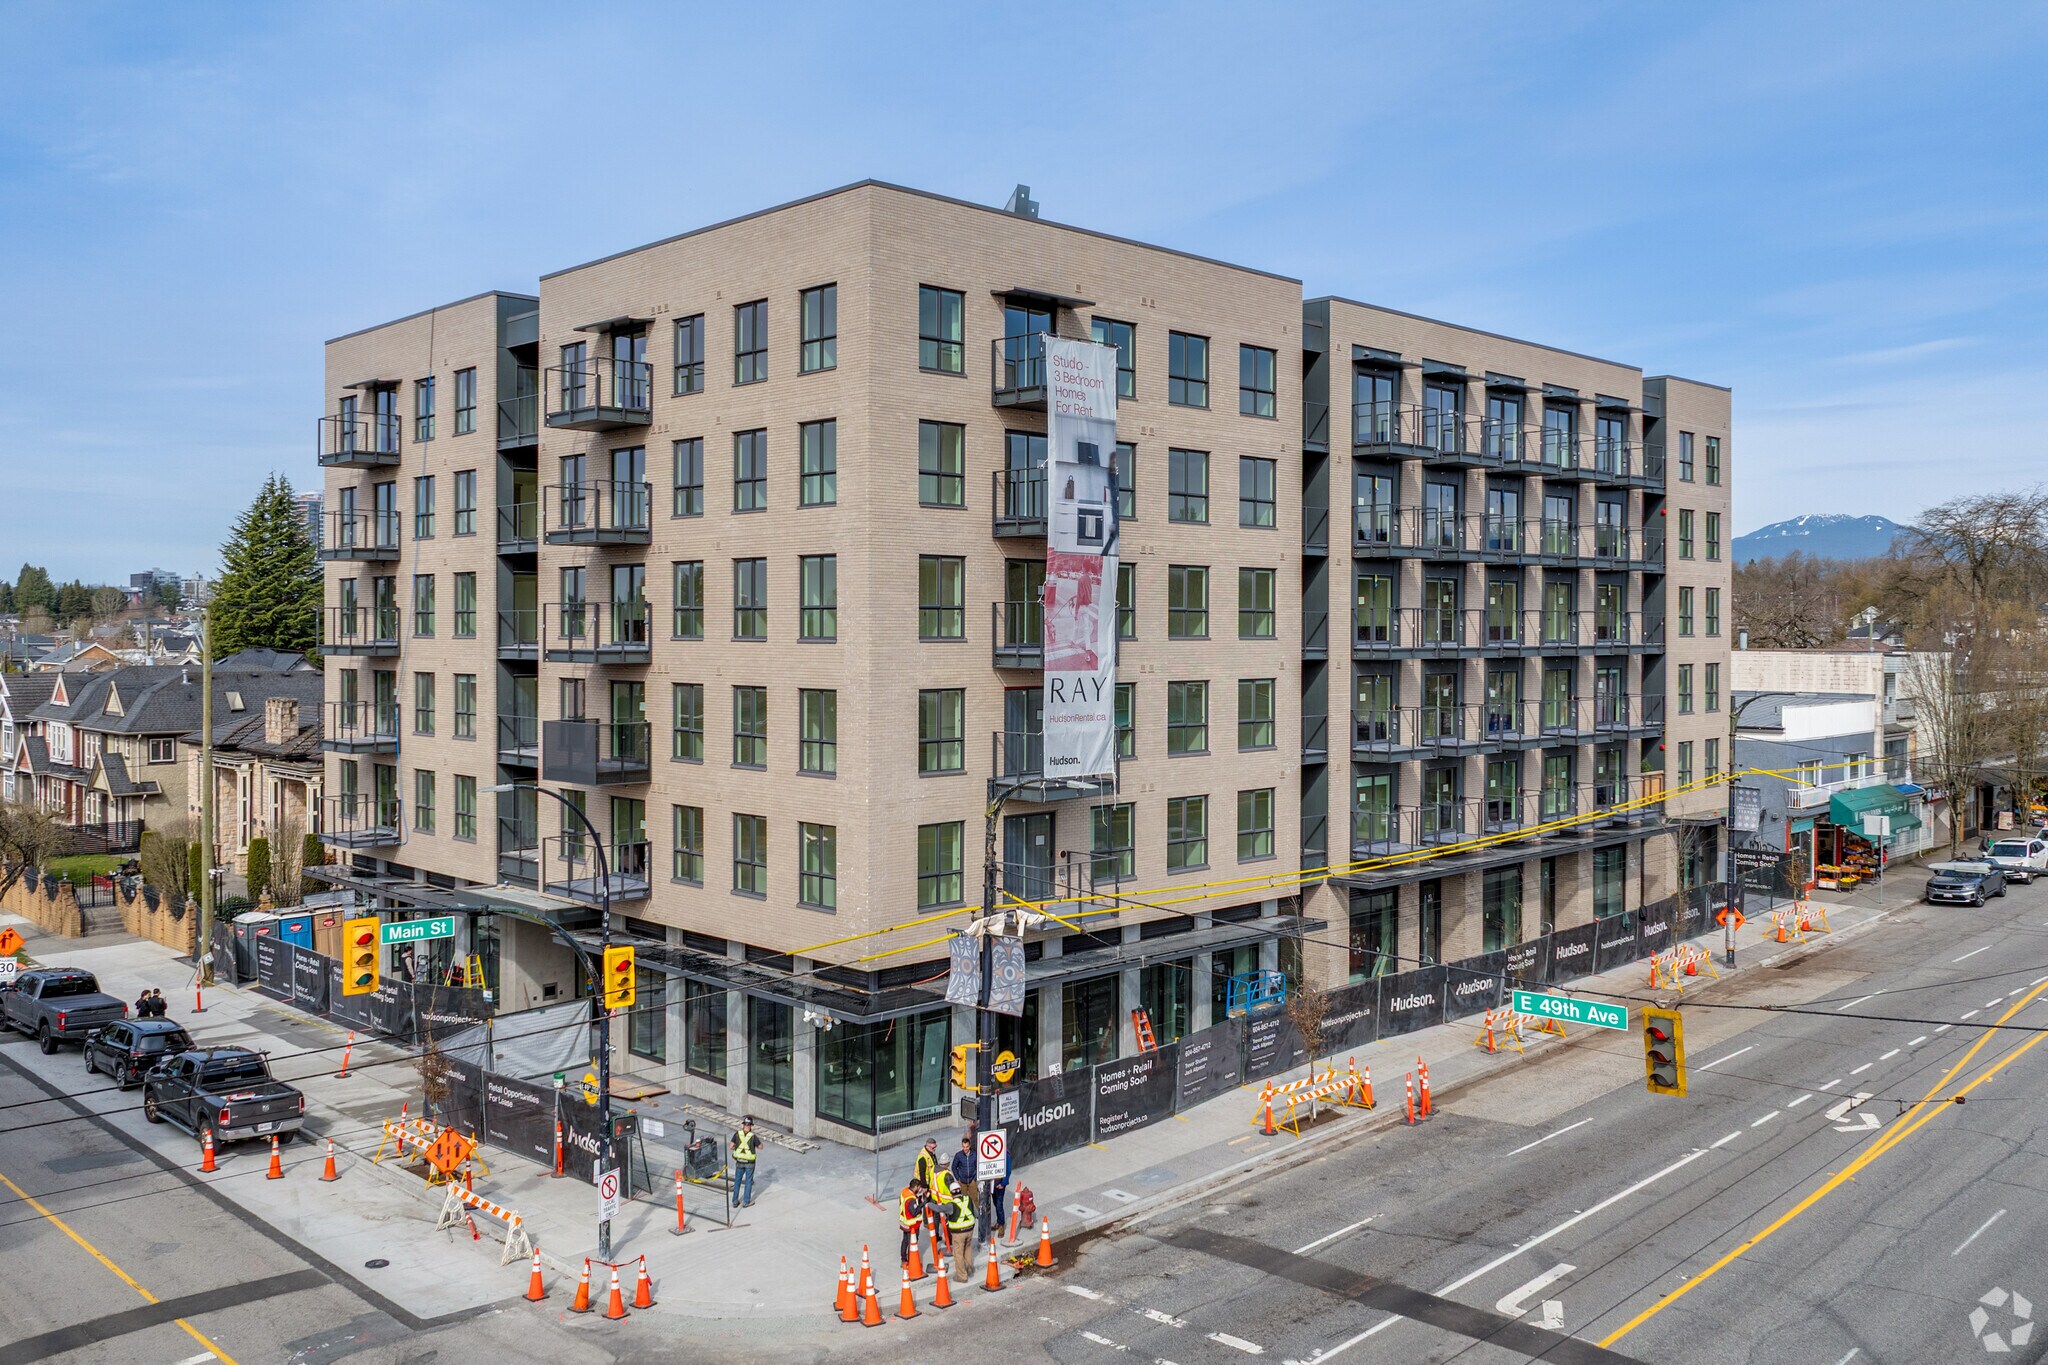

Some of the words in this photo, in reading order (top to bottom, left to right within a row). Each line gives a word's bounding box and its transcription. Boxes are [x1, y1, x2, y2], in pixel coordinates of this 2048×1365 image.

[1053, 354, 1083, 371] Studio
[1054, 370, 1062, 382] 3
[1063, 371, 1105, 390] Bedroom
[1055, 385, 1087, 401] Homes
[1056, 400, 1072, 414] For
[1074, 403, 1093, 418] Rent
[1050, 677, 1107, 704] RAY
[1049, 712, 1107, 724] HudsonRental.ca
[1049, 755, 1081, 766] Hudson.
[390, 925, 424, 940] Main
[430, 922, 447, 935] St
[1644, 920, 1668, 938] Hudson.
[1556, 942, 1589, 960] Hudson.
[0, 963, 14, 972] 30
[1390, 993, 1435, 1012] Hudson.
[1521, 995, 1532, 1011] E
[1539, 998, 1580, 1019] 49th
[1587, 1006, 1619, 1025] Ave
[1321, 1008, 1370, 1028] hudsonprojects.ca
[1101, 1070, 1126, 1084] Homes
[1133, 1060, 1152, 1074] Retail
[1100, 1080, 1128, 1094] Coming
[1130, 1074, 1147, 1086] Soon
[489, 1082, 503, 1094] Retail
[503, 1086, 540, 1105] Opportunities
[489, 1093, 498, 1102] For
[1100, 1114, 1123, 1124] Register
[1100, 1114, 1148, 1134] hudsonprojects.ca
[603, 1204, 616, 1214] TRAFFIC
[604, 1199, 616, 1207] LOCAL
[606, 1210, 615, 1218] ONLY
